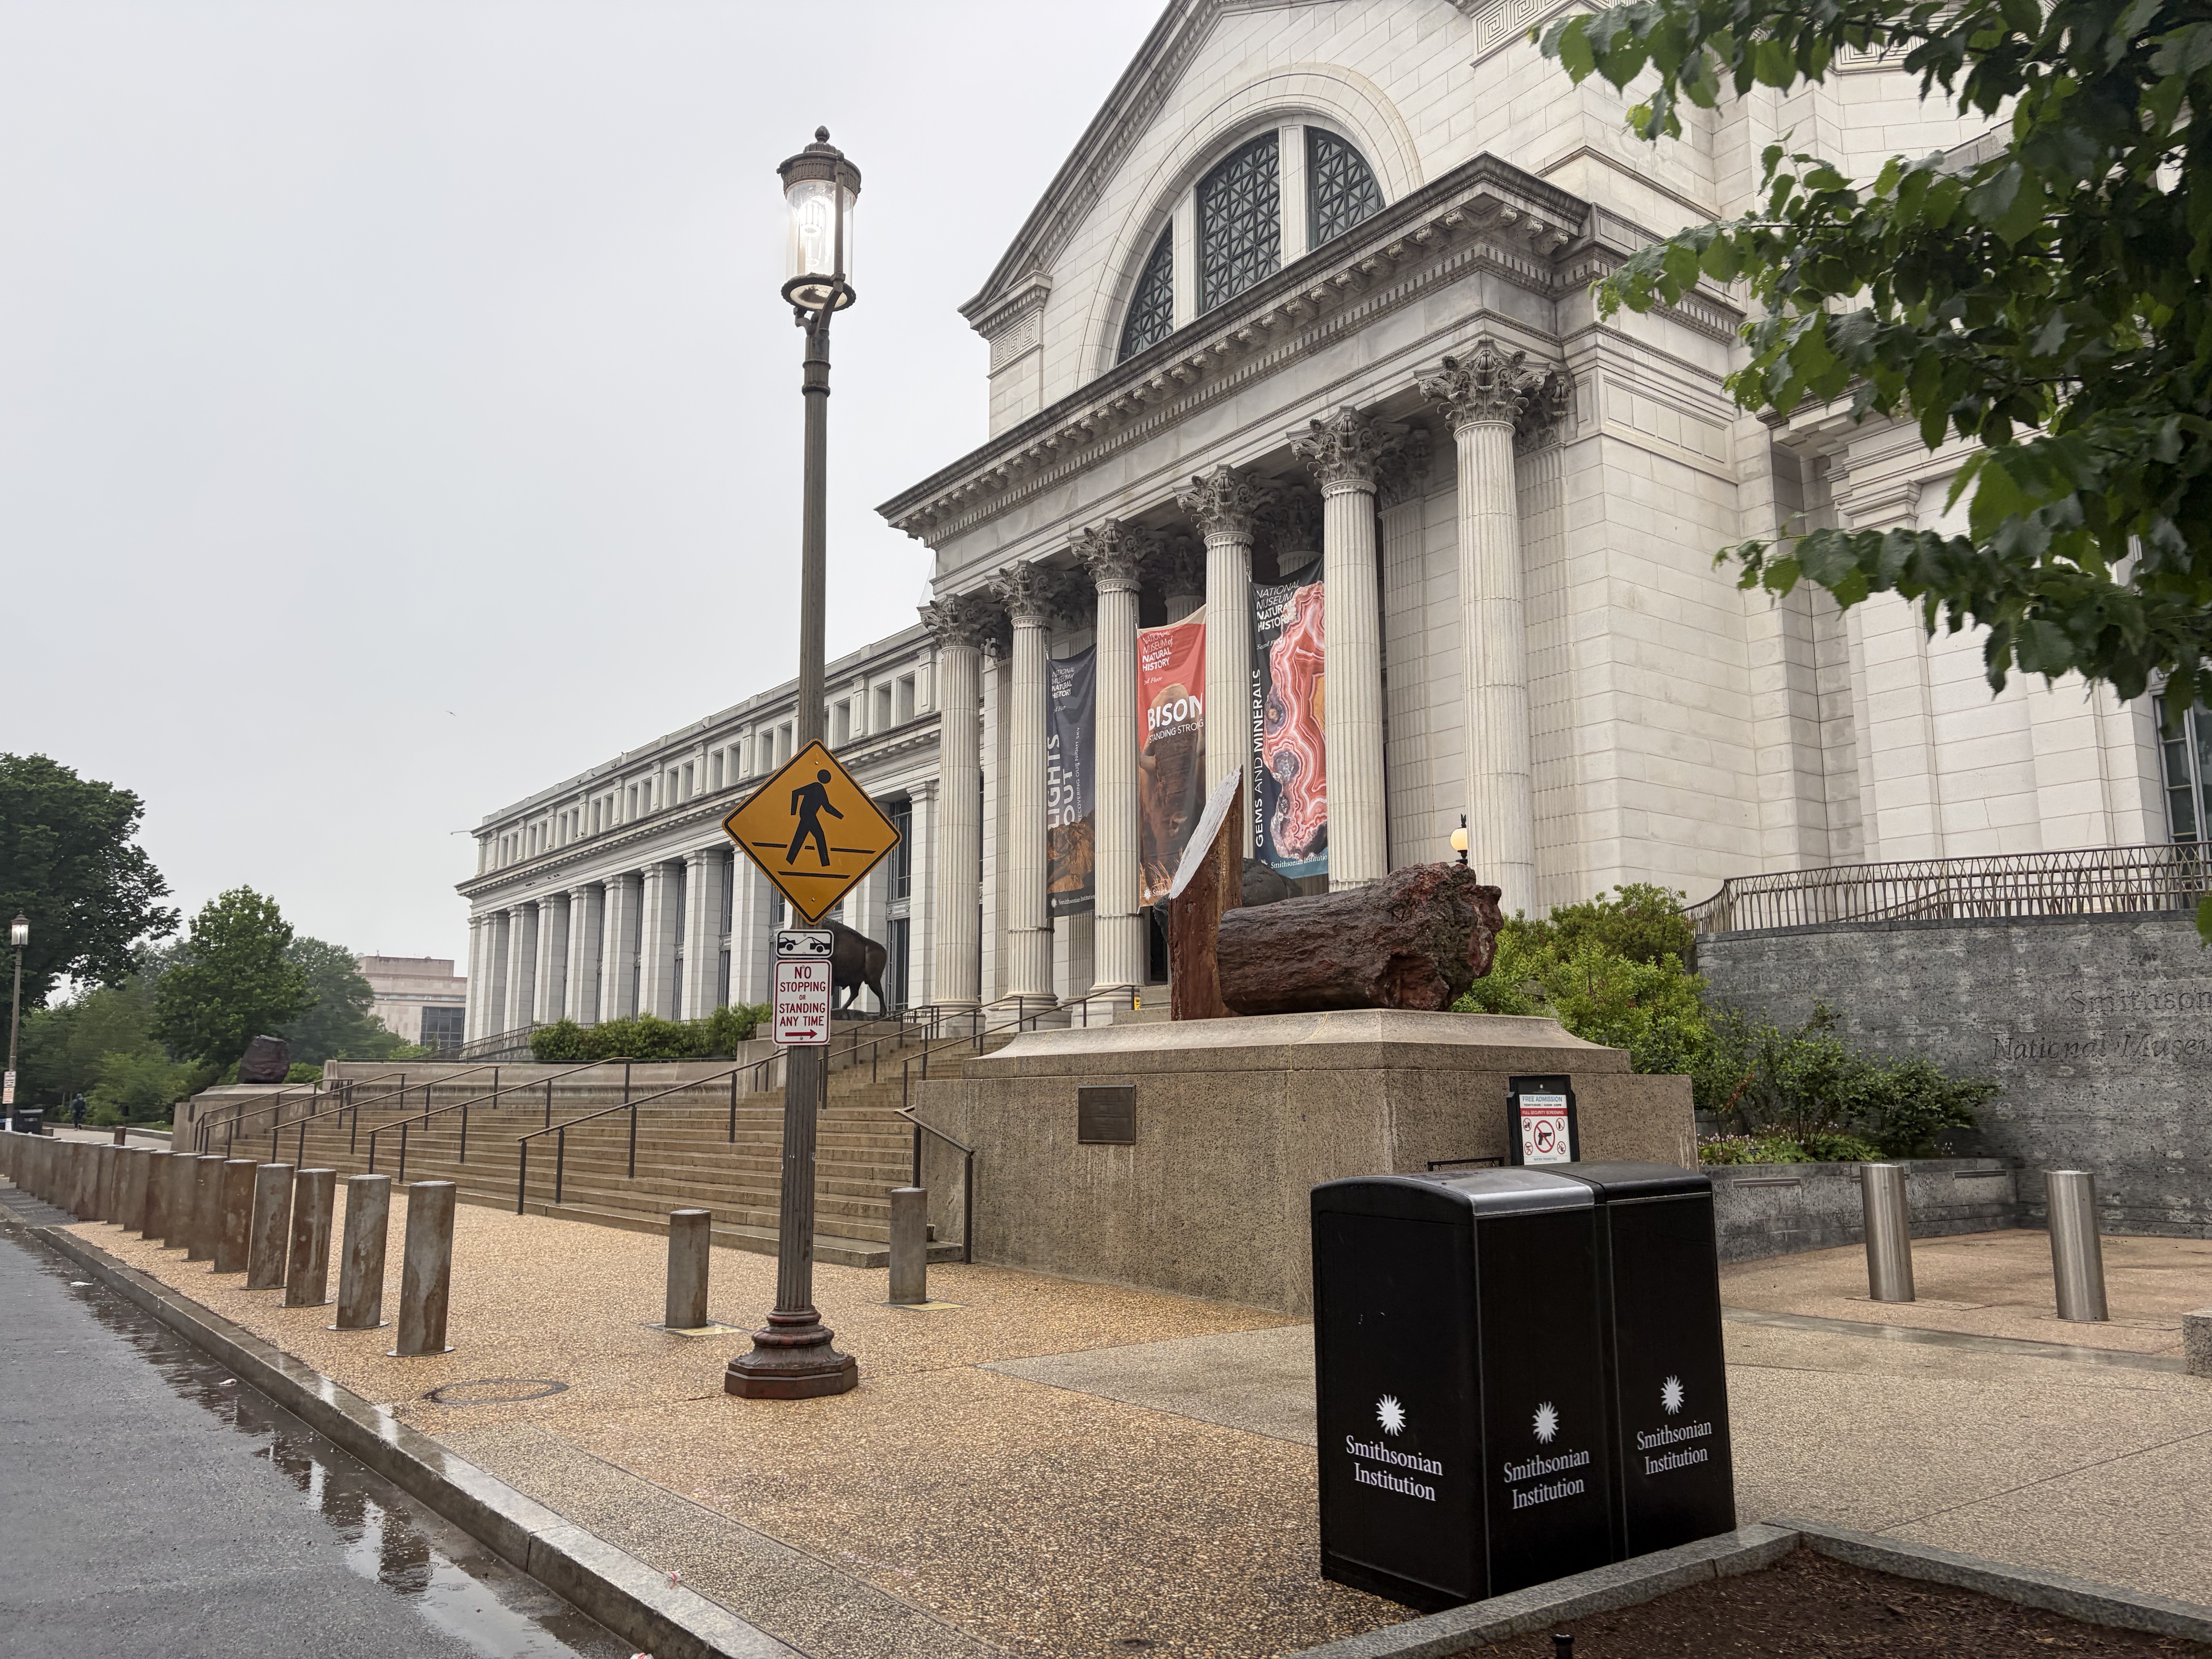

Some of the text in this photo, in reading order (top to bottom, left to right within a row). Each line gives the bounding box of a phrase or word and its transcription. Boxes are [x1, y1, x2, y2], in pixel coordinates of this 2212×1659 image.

[1256, 580, 1300, 599] NATIONAL
[1256, 591, 1293, 610] MUSEUM
[1143, 630, 1171, 646] NATIONAL
[1143, 635, 1173, 654] MUSEUM of
[1142, 647, 1172, 663] NATURAL
[1142, 657, 1170, 672] HISTORY
[1051, 680, 1072, 692] NATURAL
[1052, 688, 1071, 699] HISTORY
[1147, 692, 1203, 732] BISON
[1149, 727, 1176, 743] STANDING
[1252, 669, 1264, 847] GEMS AND MINERALS
[1047, 734, 1061, 831] LIGHTS
[1063, 769, 1075, 826] OUT
[1271, 854, 1328, 869] Smithsonian Institutio
[795, 966, 812, 979] NO
[780, 981, 826, 992] STOPPING
[779, 1003, 825, 1013] STANDING
[2069, 986, 2212, 1013] Smithson
[780, 1016, 824, 1027] ANY TIME
[1992, 1033, 2212, 1060] National Museu
[1637, 1420, 1712, 1450] Smithsonian
[1346, 1435, 1444, 1476] Smithsonian
[1644, 1447, 1709, 1475] Institution
[1504, 1449, 1590, 1483] Smithsonian
[1354, 1462, 1436, 1501] Institution
[1512, 1478, 1585, 1510] Institution
